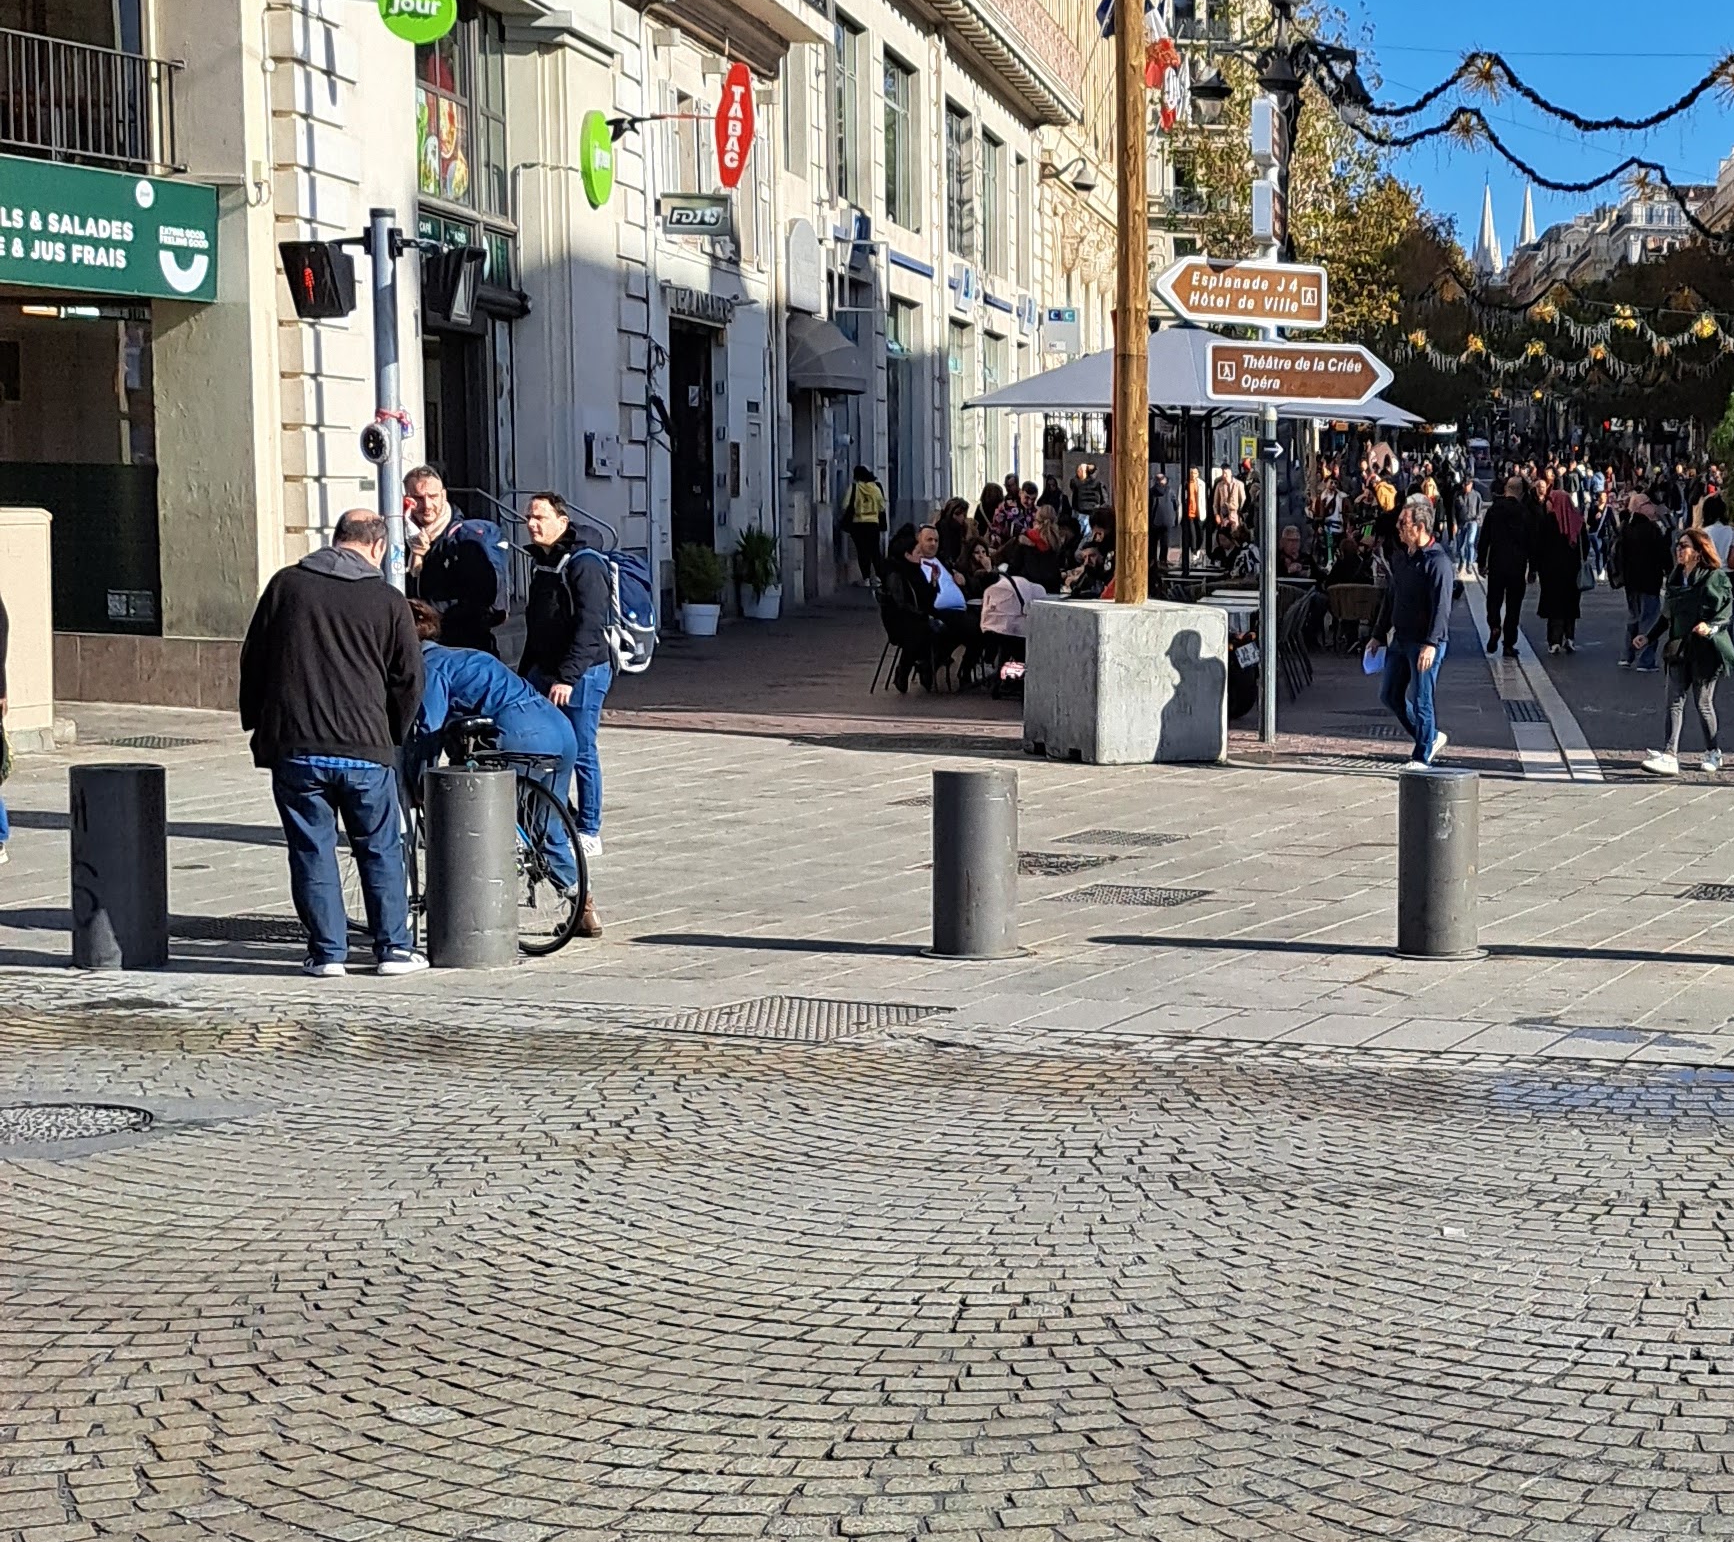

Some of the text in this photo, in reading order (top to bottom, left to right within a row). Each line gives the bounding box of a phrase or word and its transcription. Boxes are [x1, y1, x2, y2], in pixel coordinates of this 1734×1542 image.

[723, 84, 745, 169] TABAC
[30, 210, 43, 231] &
[48, 212, 134, 242] SALADES
[671, 209, 703, 224] FDJ
[11, 236, 25, 258] &
[30, 239, 66, 263] JUS
[71, 243, 127, 269] FRAIS
[1191, 271, 1299, 294] Esplanade J 4
[1189, 290, 1299, 314] Hôtel de Ville
[1242, 354, 1363, 373] Théâtre de la Criée
[1241, 374, 1281, 391] Opéra
